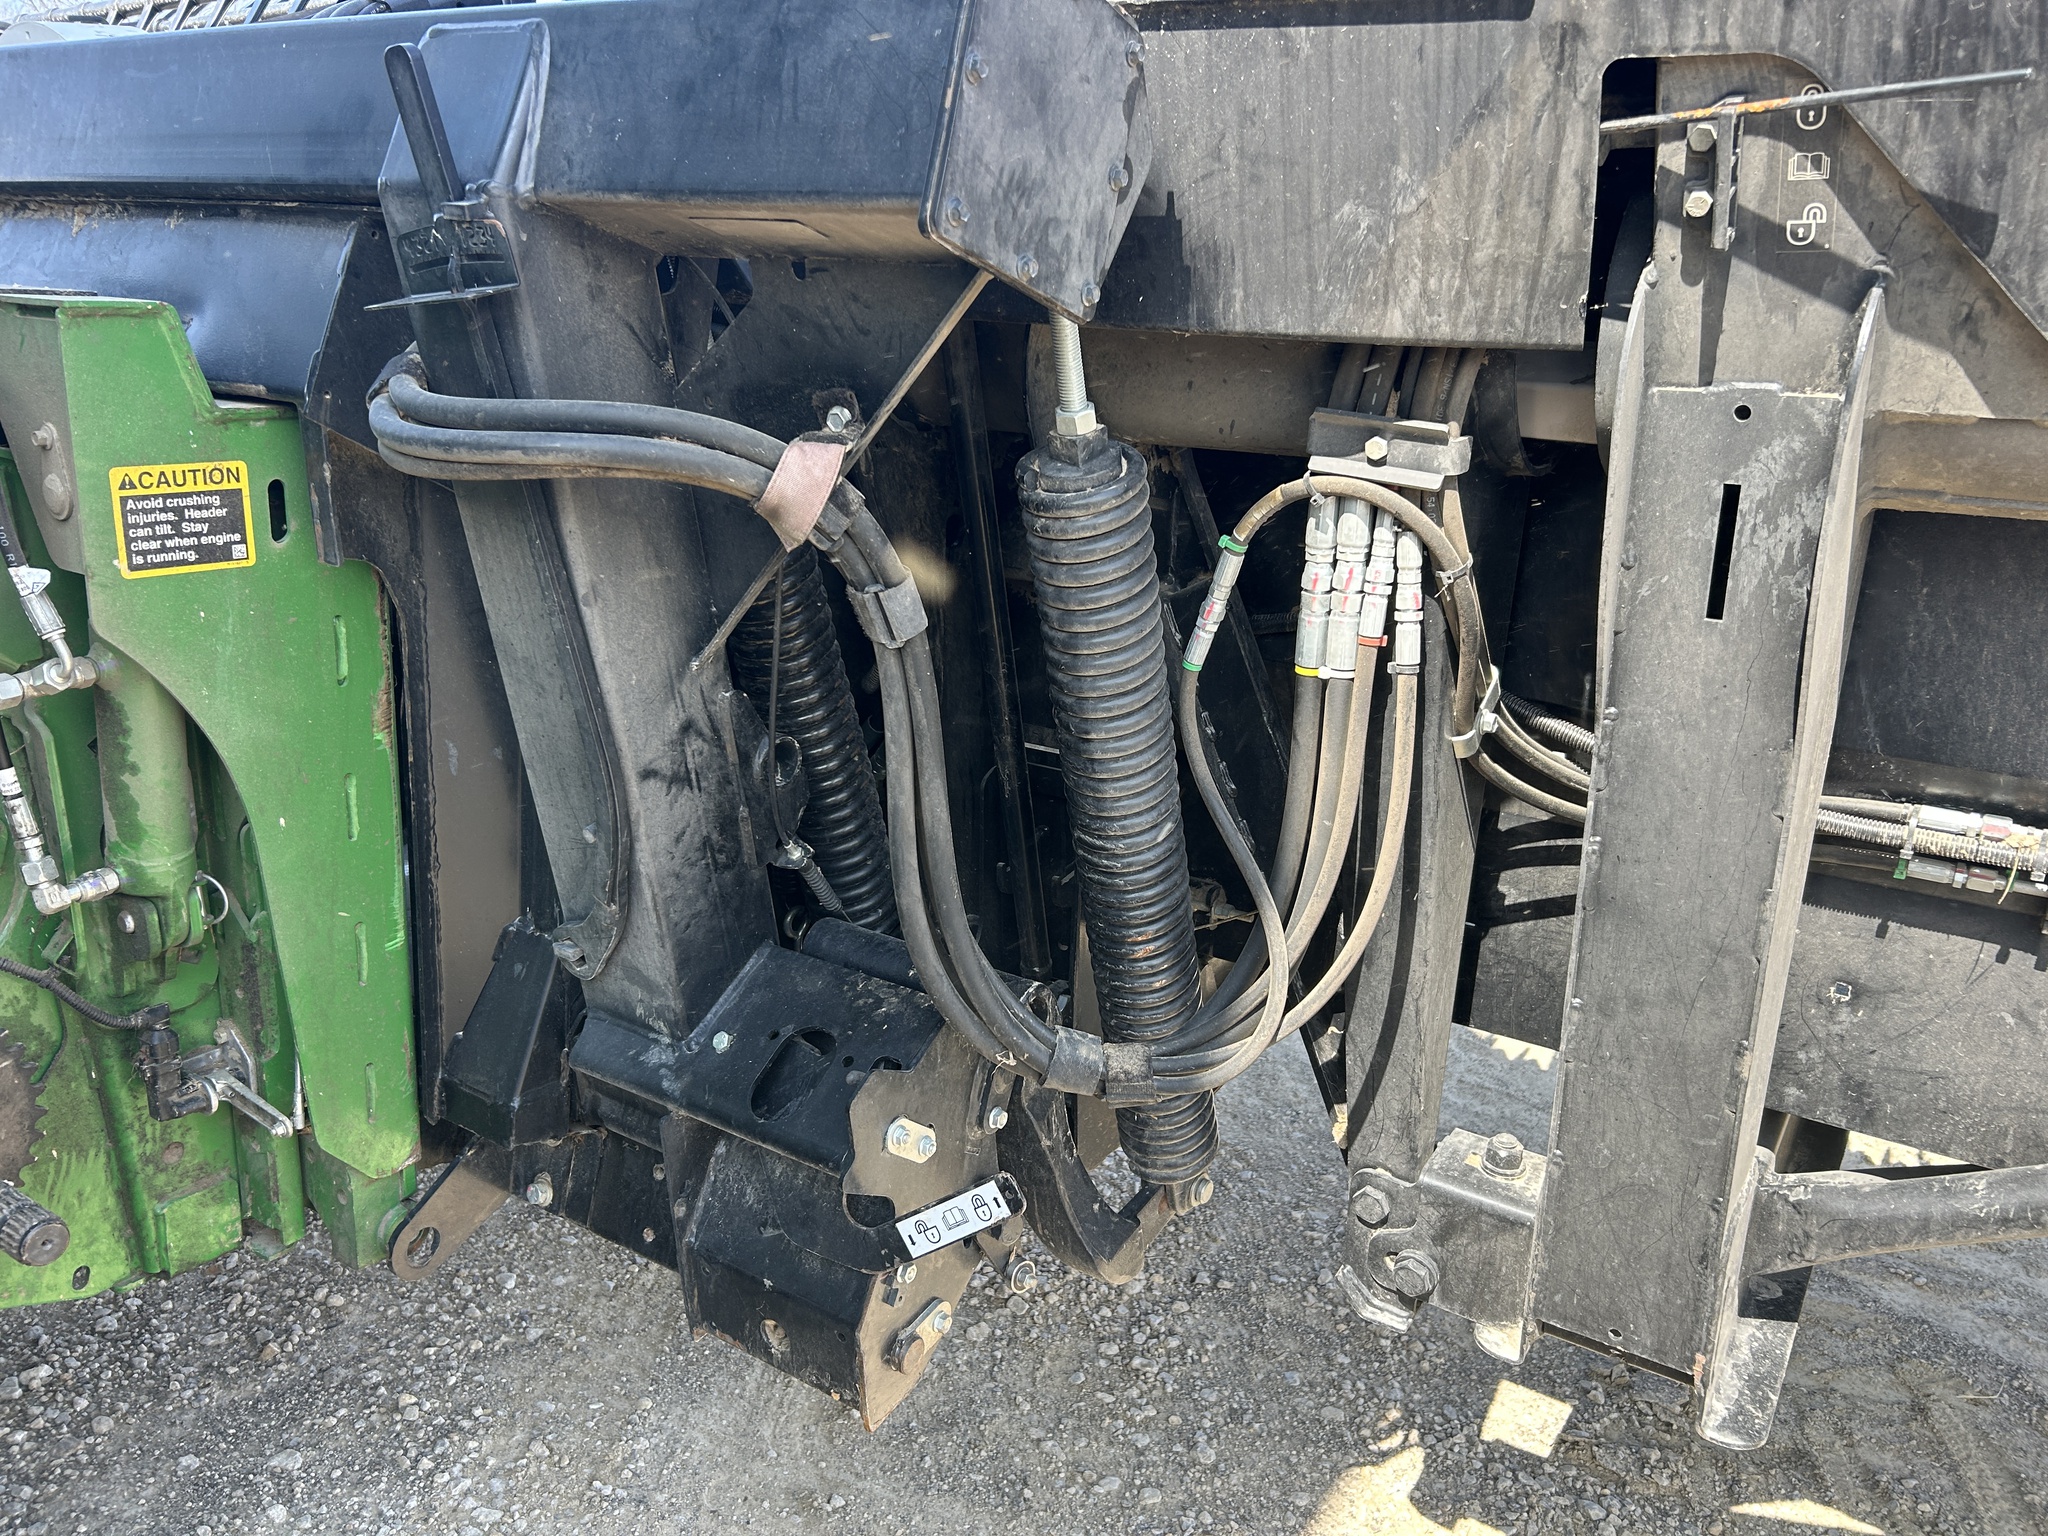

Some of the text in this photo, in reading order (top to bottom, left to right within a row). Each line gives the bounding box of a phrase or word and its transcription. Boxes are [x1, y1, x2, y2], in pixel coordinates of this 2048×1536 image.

[138, 467, 240, 489] CAUTION
[126, 494, 220, 510] Avoid crushing
[127, 507, 227, 525] injuries. Header
[128, 522, 209, 537] can tilt. Stay
[130, 532, 241, 551] clear when engine
[132, 549, 199, 564] is running.
